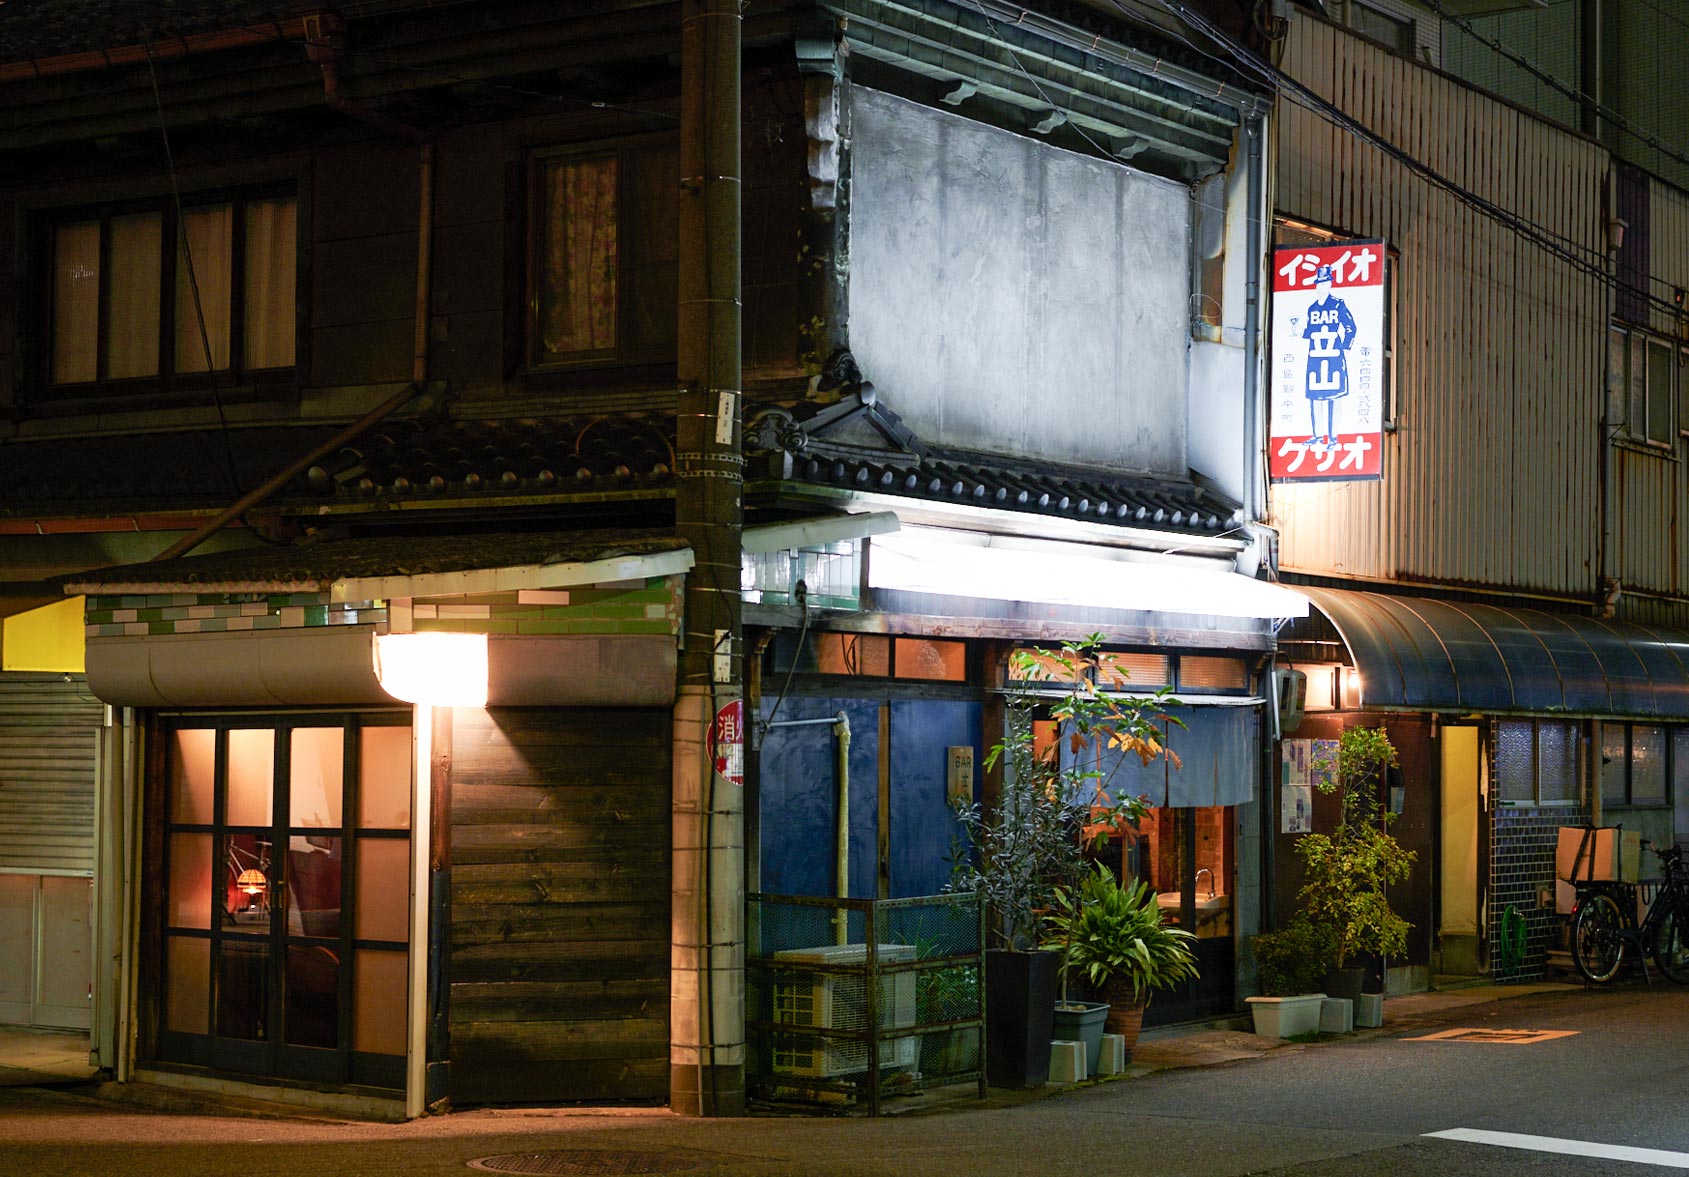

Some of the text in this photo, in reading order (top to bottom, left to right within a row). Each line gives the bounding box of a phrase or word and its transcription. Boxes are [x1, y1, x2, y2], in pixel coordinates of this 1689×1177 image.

[1310, 310, 1339, 325] BAR
[1309, 325, 1341, 391] 立山
[1278, 435, 1372, 473] ケサオ
[955, 756, 971, 768] BAR
